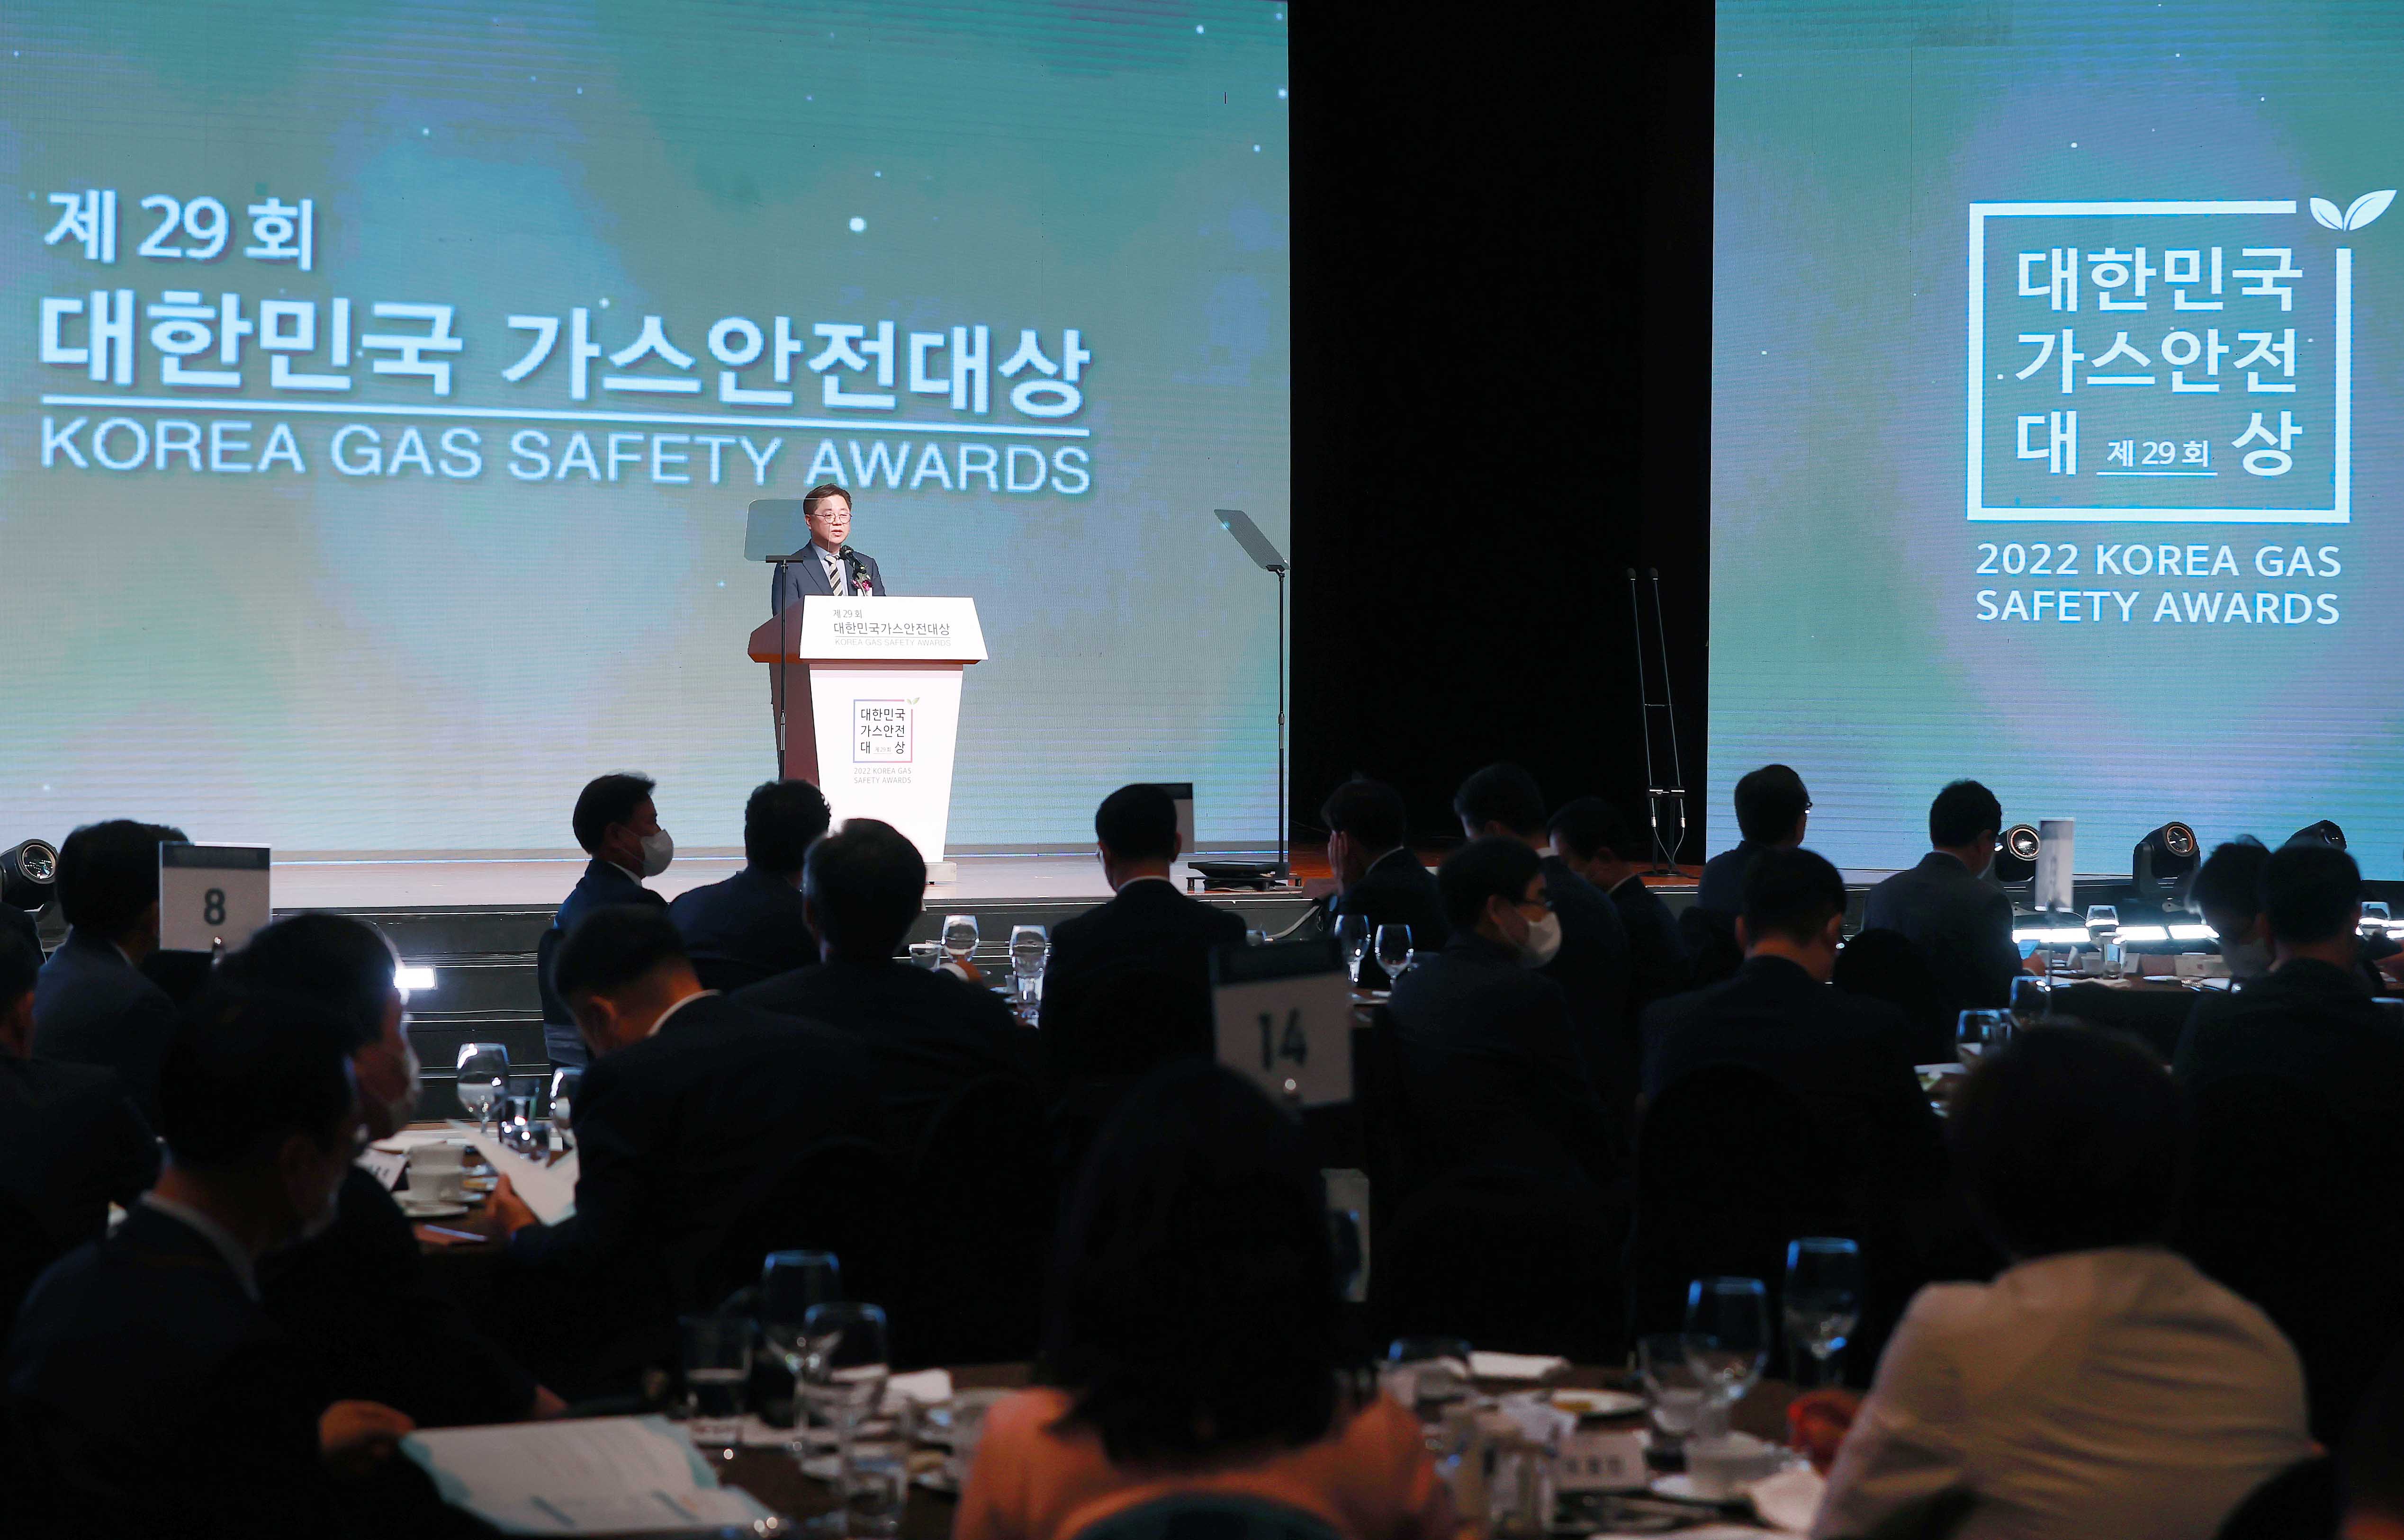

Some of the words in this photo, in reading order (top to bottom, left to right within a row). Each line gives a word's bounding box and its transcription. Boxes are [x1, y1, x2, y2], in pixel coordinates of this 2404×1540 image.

[44, 189, 117, 263] 제
[137, 194, 231, 260] 29
[243, 196, 315, 271] 회
[2017, 247, 2304, 312] 대한민국
[39, 288, 464, 396] 대한민국
[501, 306, 1092, 419] 가스안전대상
[2016, 328, 2297, 394] 가스안전
[41, 416, 306, 474] KOREA
[330, 422, 484, 480] GAS
[507, 428, 783, 486] SAFETY
[803, 438, 1091, 495] AWARDS
[2016, 409, 2077, 475] 대
[2231, 410, 2303, 477] 상
[2107, 439, 2134, 467] 제
[2141, 441, 2176, 466] 29
[2181, 440, 2209, 467] 회
[1975, 543, 2080, 575] 2022
[2096, 544, 2240, 576] KOREA
[2254, 545, 2342, 578] GAS
[833, 609, 841, 618] 제
[843, 609, 853, 618] 29
[855, 609, 863, 619] 회
[1975, 589, 2140, 622] SAFETY
[2153, 591, 2341, 625] AWARDS
[834, 622, 950, 636] 대한민국가스안전대상
[917, 639, 951, 647] AWARDS
[861, 708, 906, 721] 대한민국
[861, 725, 905, 738] 가스안전
[861, 741, 871, 754] 대
[894, 741, 905, 754] 상
[203, 887, 226, 926] 8
[1258, 1007, 1308, 1073] 14
